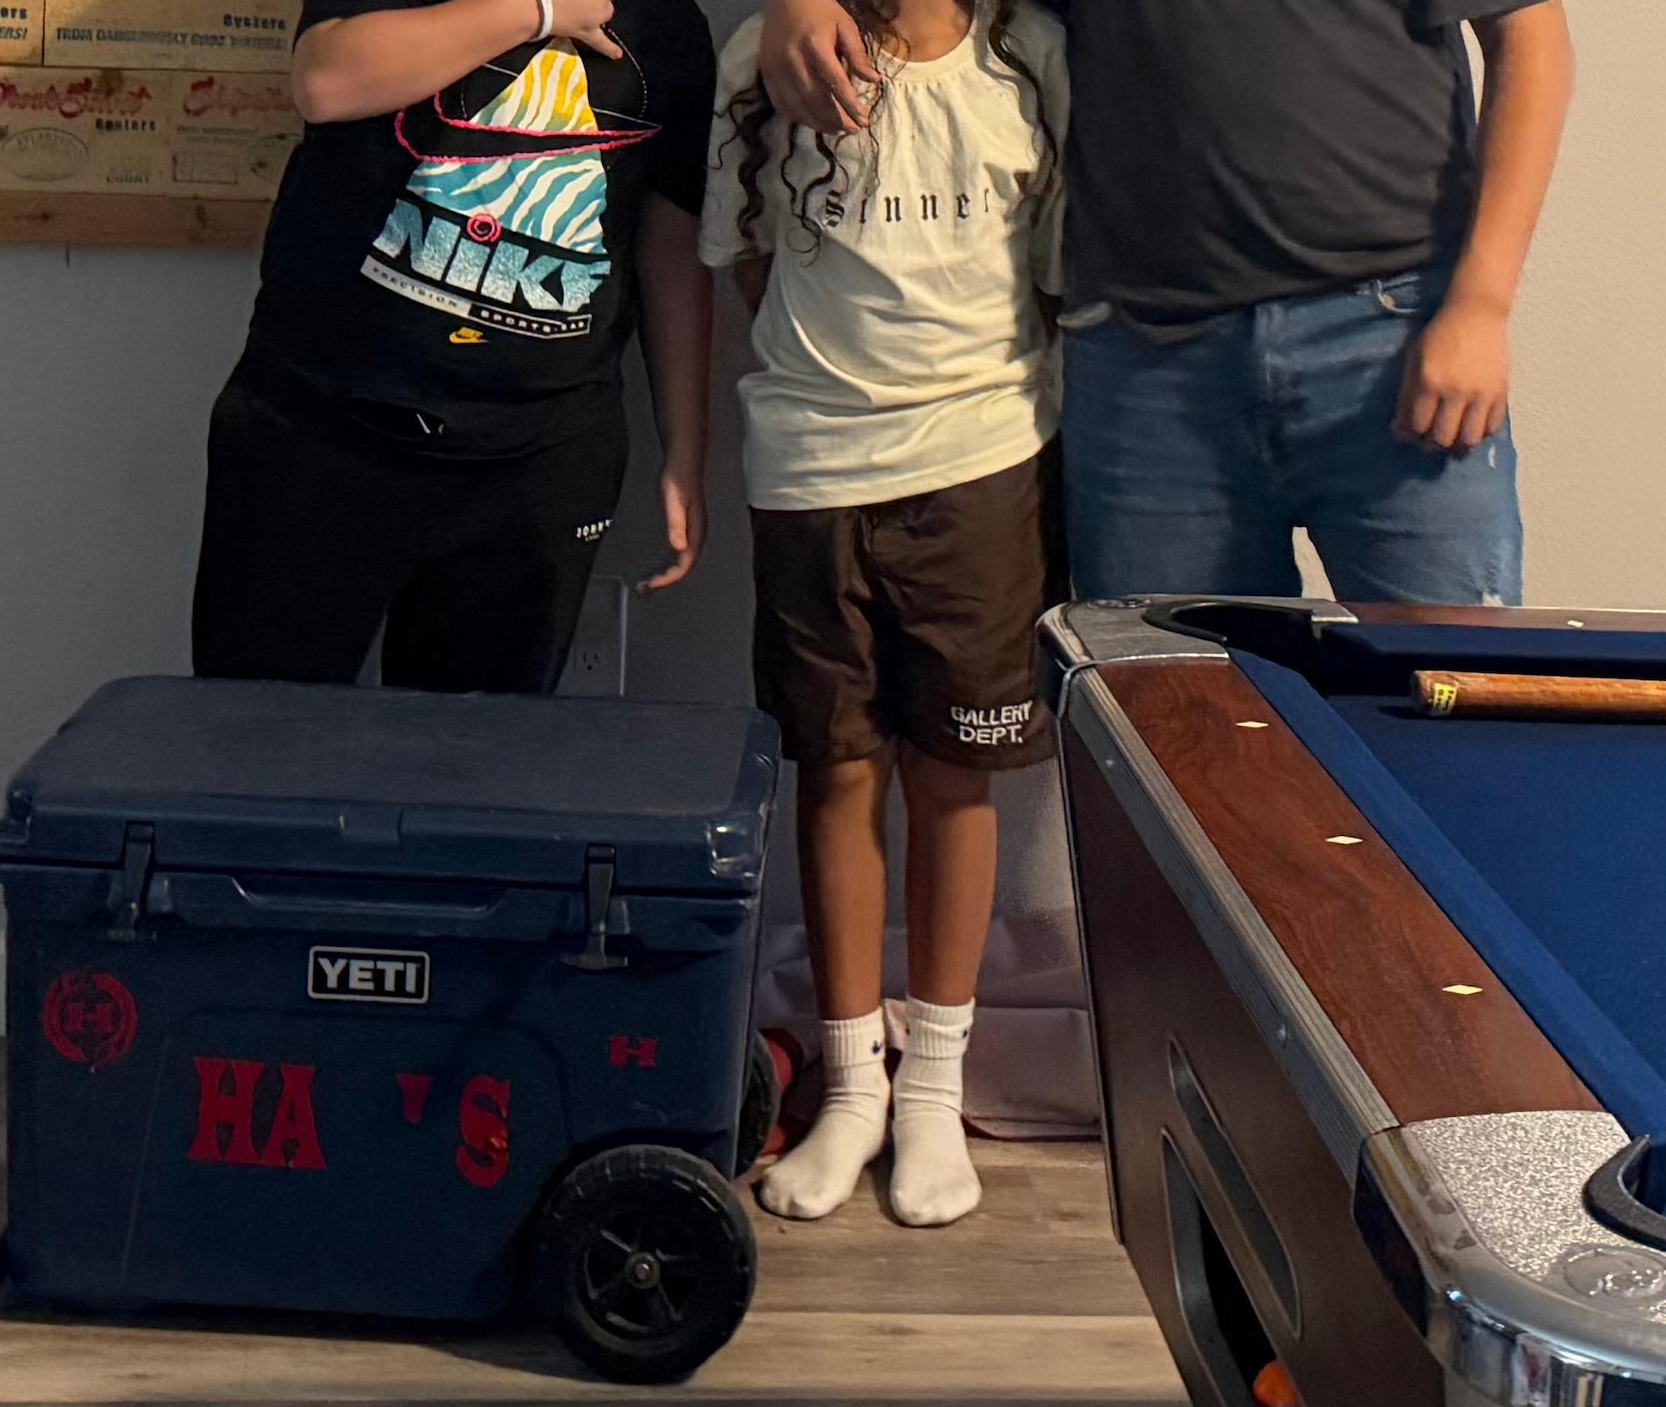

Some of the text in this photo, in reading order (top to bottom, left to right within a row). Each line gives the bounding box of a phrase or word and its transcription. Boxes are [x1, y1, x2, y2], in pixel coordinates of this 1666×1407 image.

[372, 198, 611, 313] NIKE
[951, 700, 1033, 725] GALLERY
[959, 725, 1023, 745] DEPT.
[316, 955, 420, 995] YETI
[188, 1055, 327, 1171] HA
